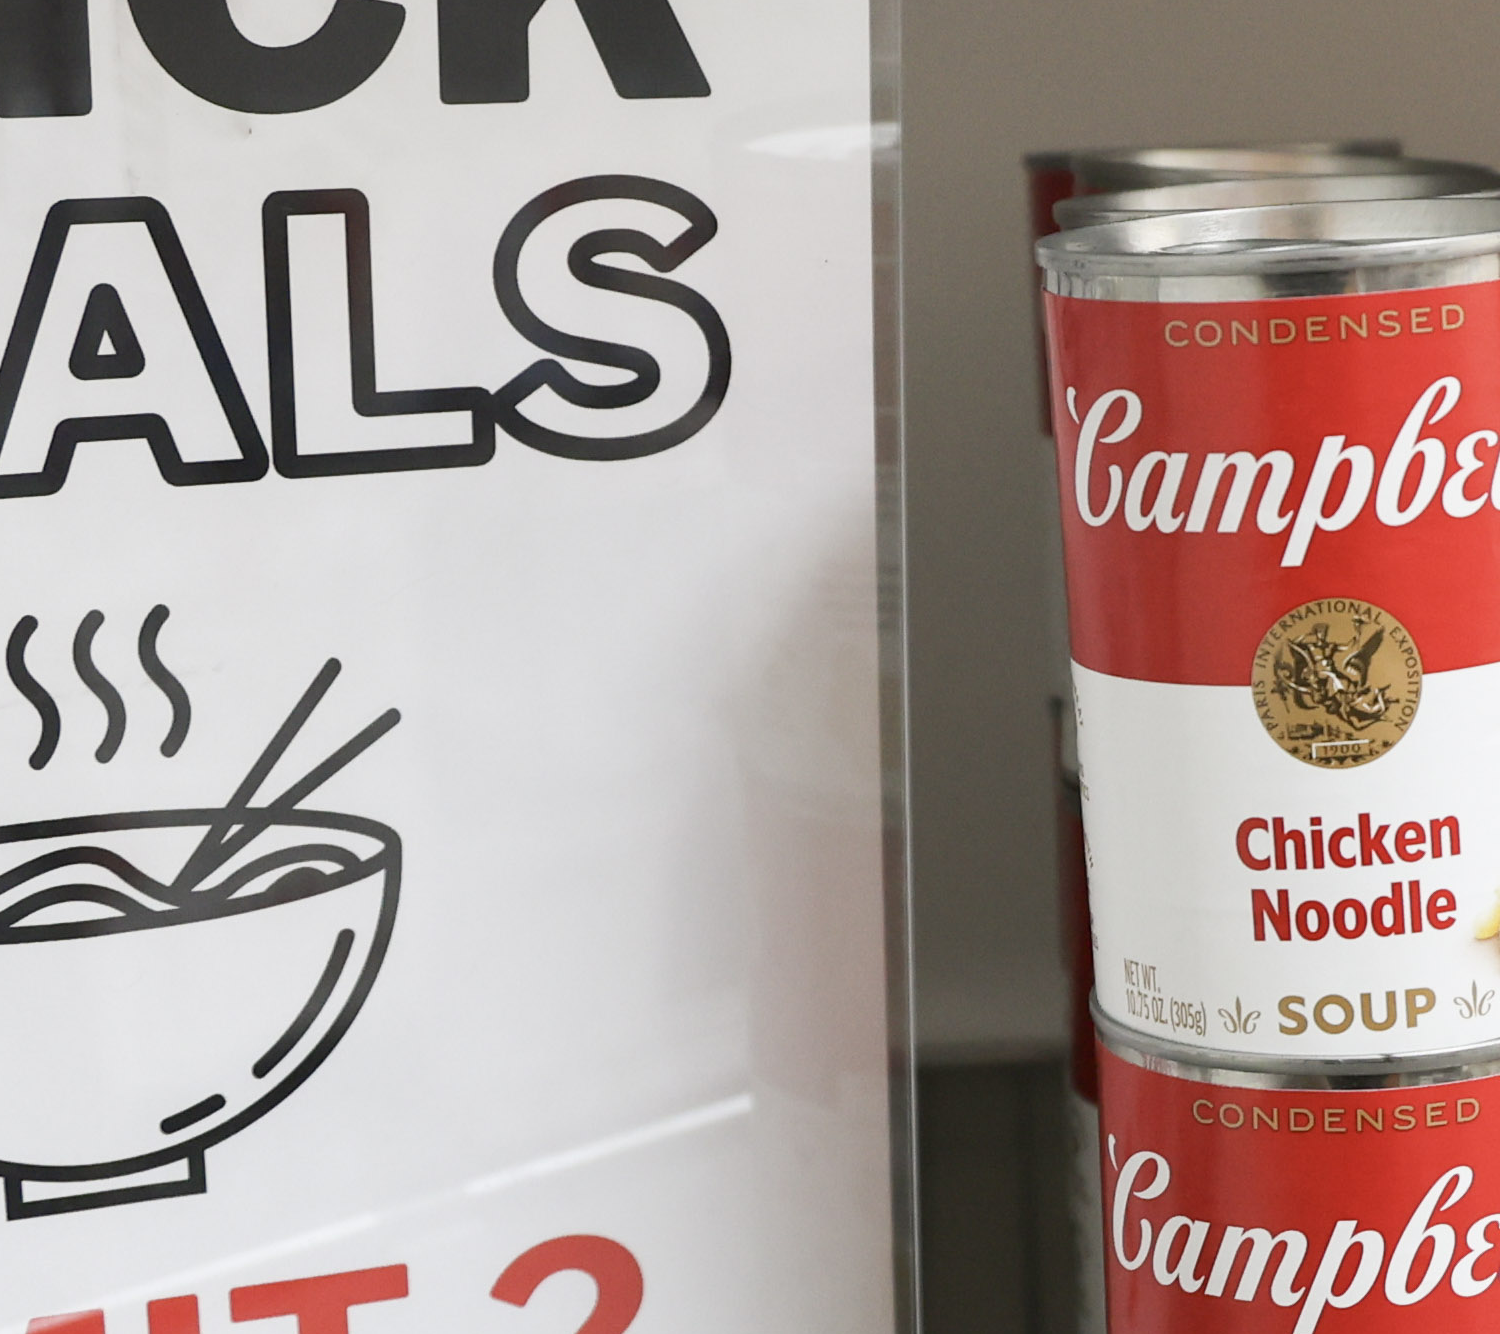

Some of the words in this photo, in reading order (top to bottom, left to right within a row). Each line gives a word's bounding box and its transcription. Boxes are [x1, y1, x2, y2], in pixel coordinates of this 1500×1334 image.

[1163, 304, 1466, 349] CONDENSED
[1255, 600, 1381, 668] INTERNATIONAL
[1389, 626, 1419, 732] EXPOSITION
[1253, 680, 1278, 731] PARIS
[1235, 812, 1462, 874] Chicken
[1250, 879, 1457, 943] Noodle
[1124, 957, 1140, 983] NET
[1170, 996, 1206, 1037] (305g)
[1278, 987, 1436, 1036] SOUP
[1191, 1096, 1481, 1133] CONDENSED
